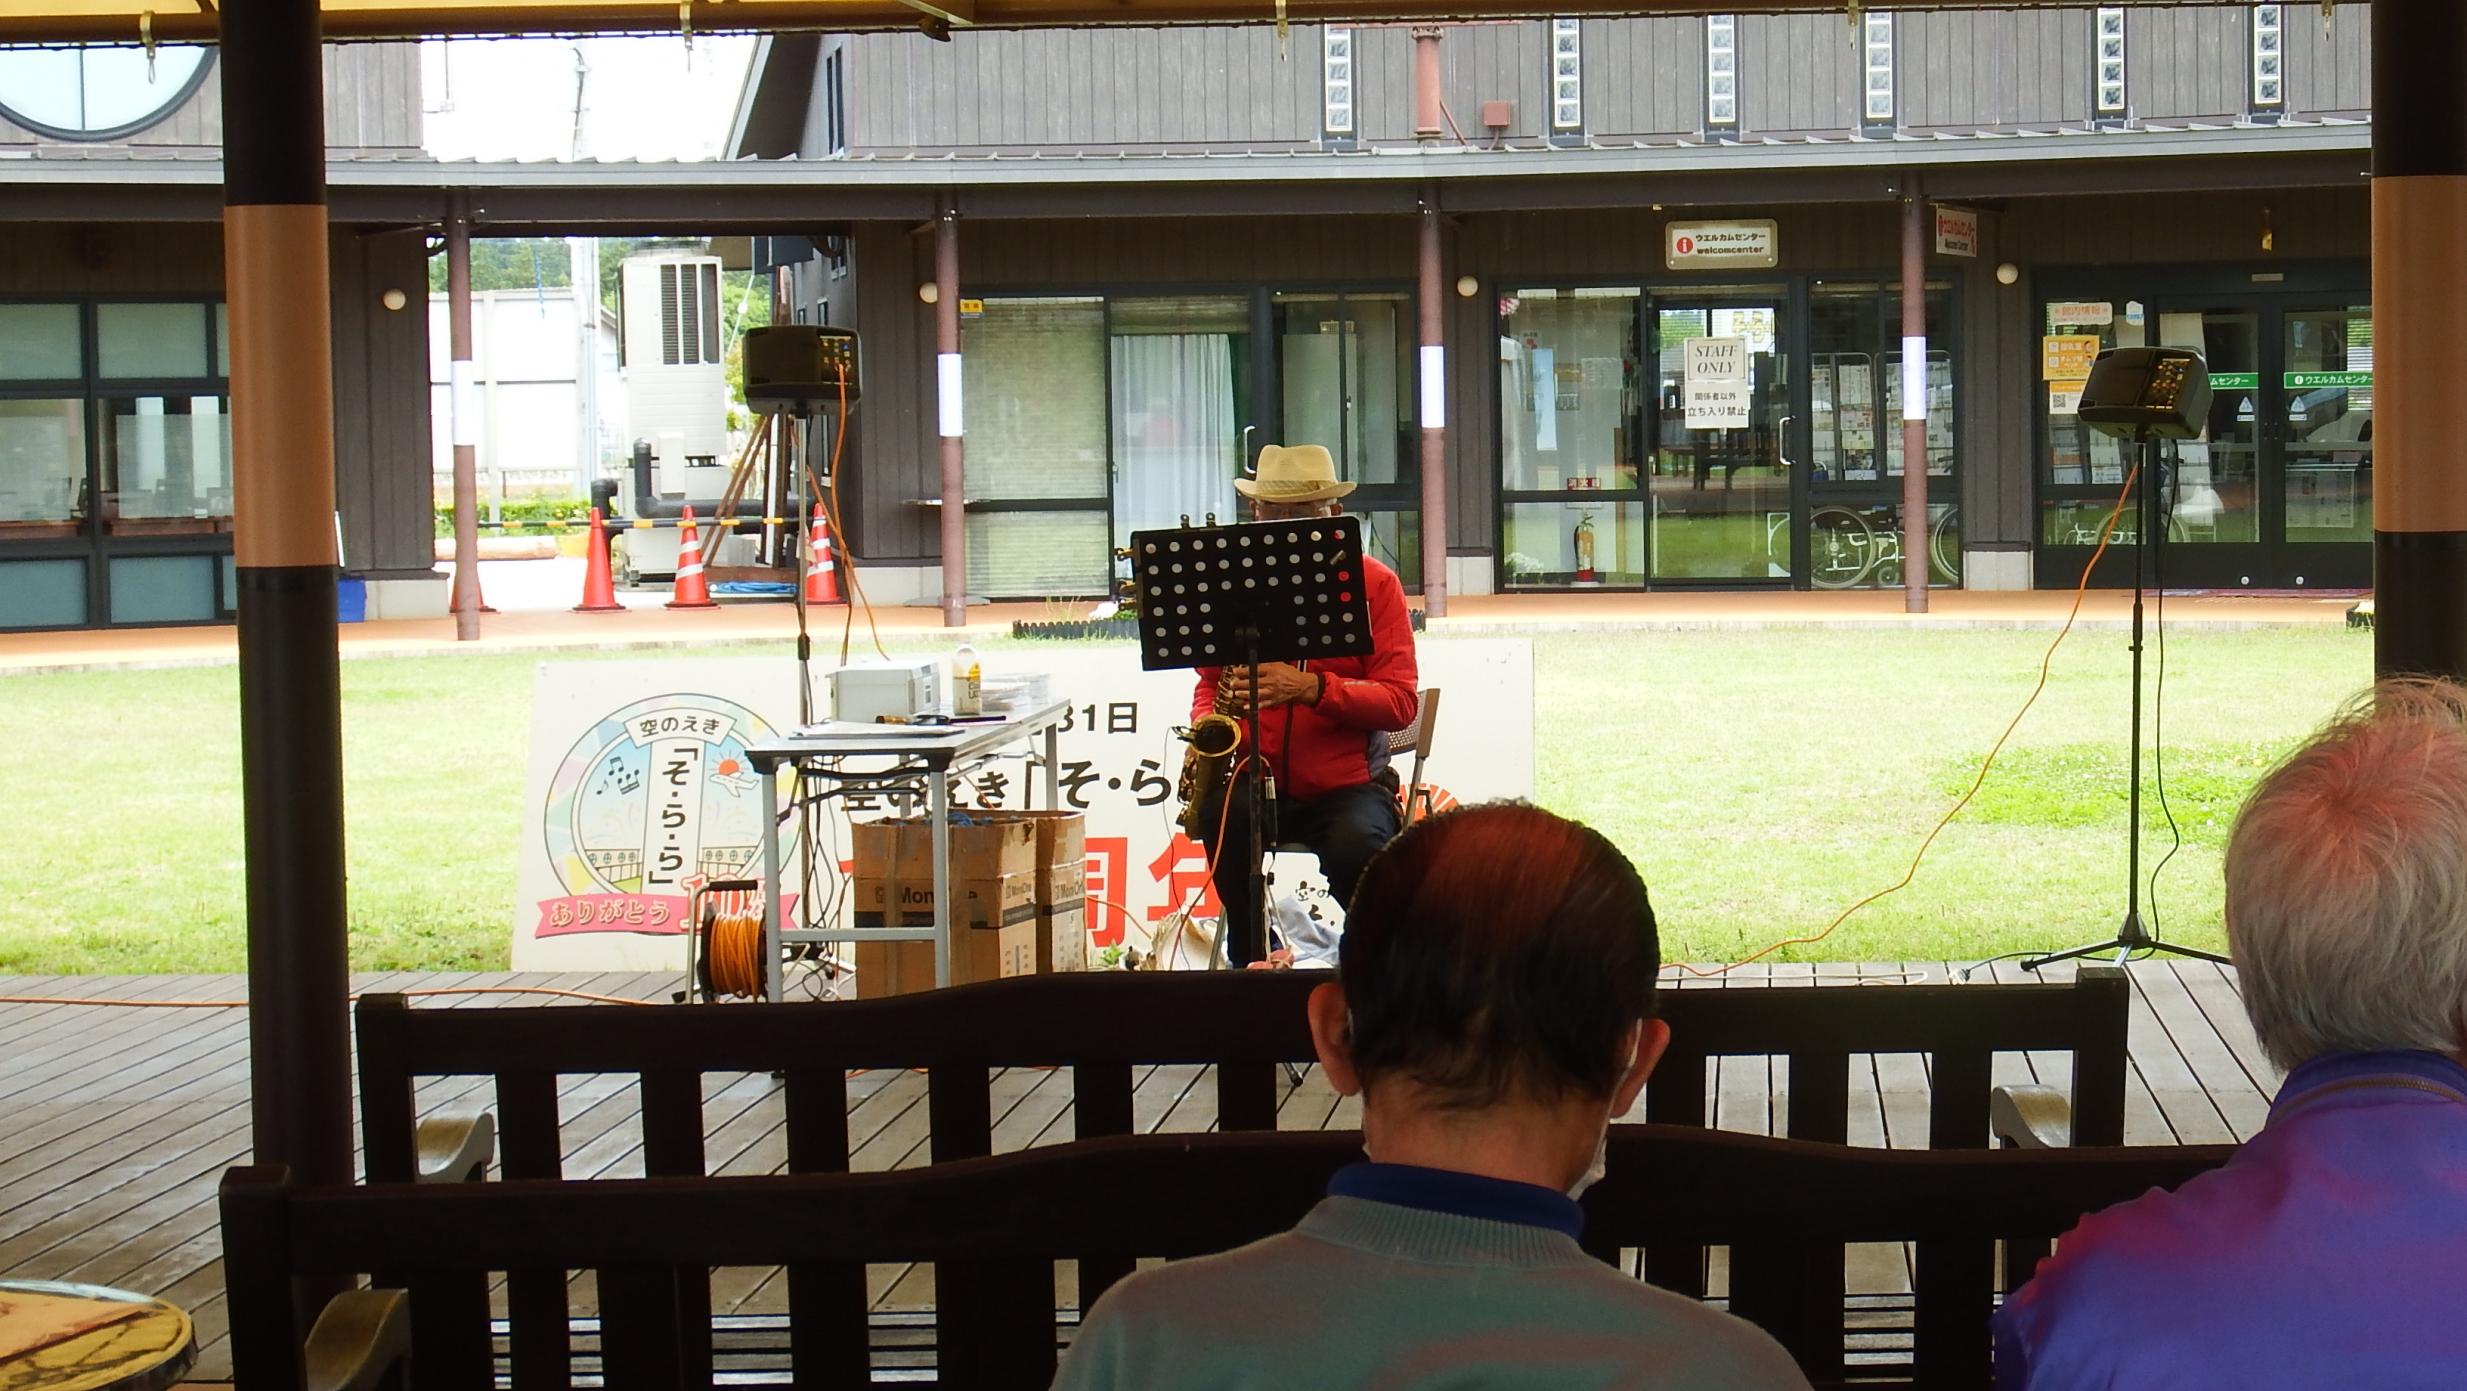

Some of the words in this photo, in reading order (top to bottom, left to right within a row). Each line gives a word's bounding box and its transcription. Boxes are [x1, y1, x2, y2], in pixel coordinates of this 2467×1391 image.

[1695, 232, 1766, 242] ウエルカムセンター
[1695, 344, 1738, 358] STAFF
[1697, 361, 1736, 374] ONLY
[1694, 392, 1737, 401] 関係者以外
[1687, 406, 1747, 417] 立ち入り禁止
[639, 715, 720, 738] 空のえき
[550, 899, 671, 927] ありがとう
